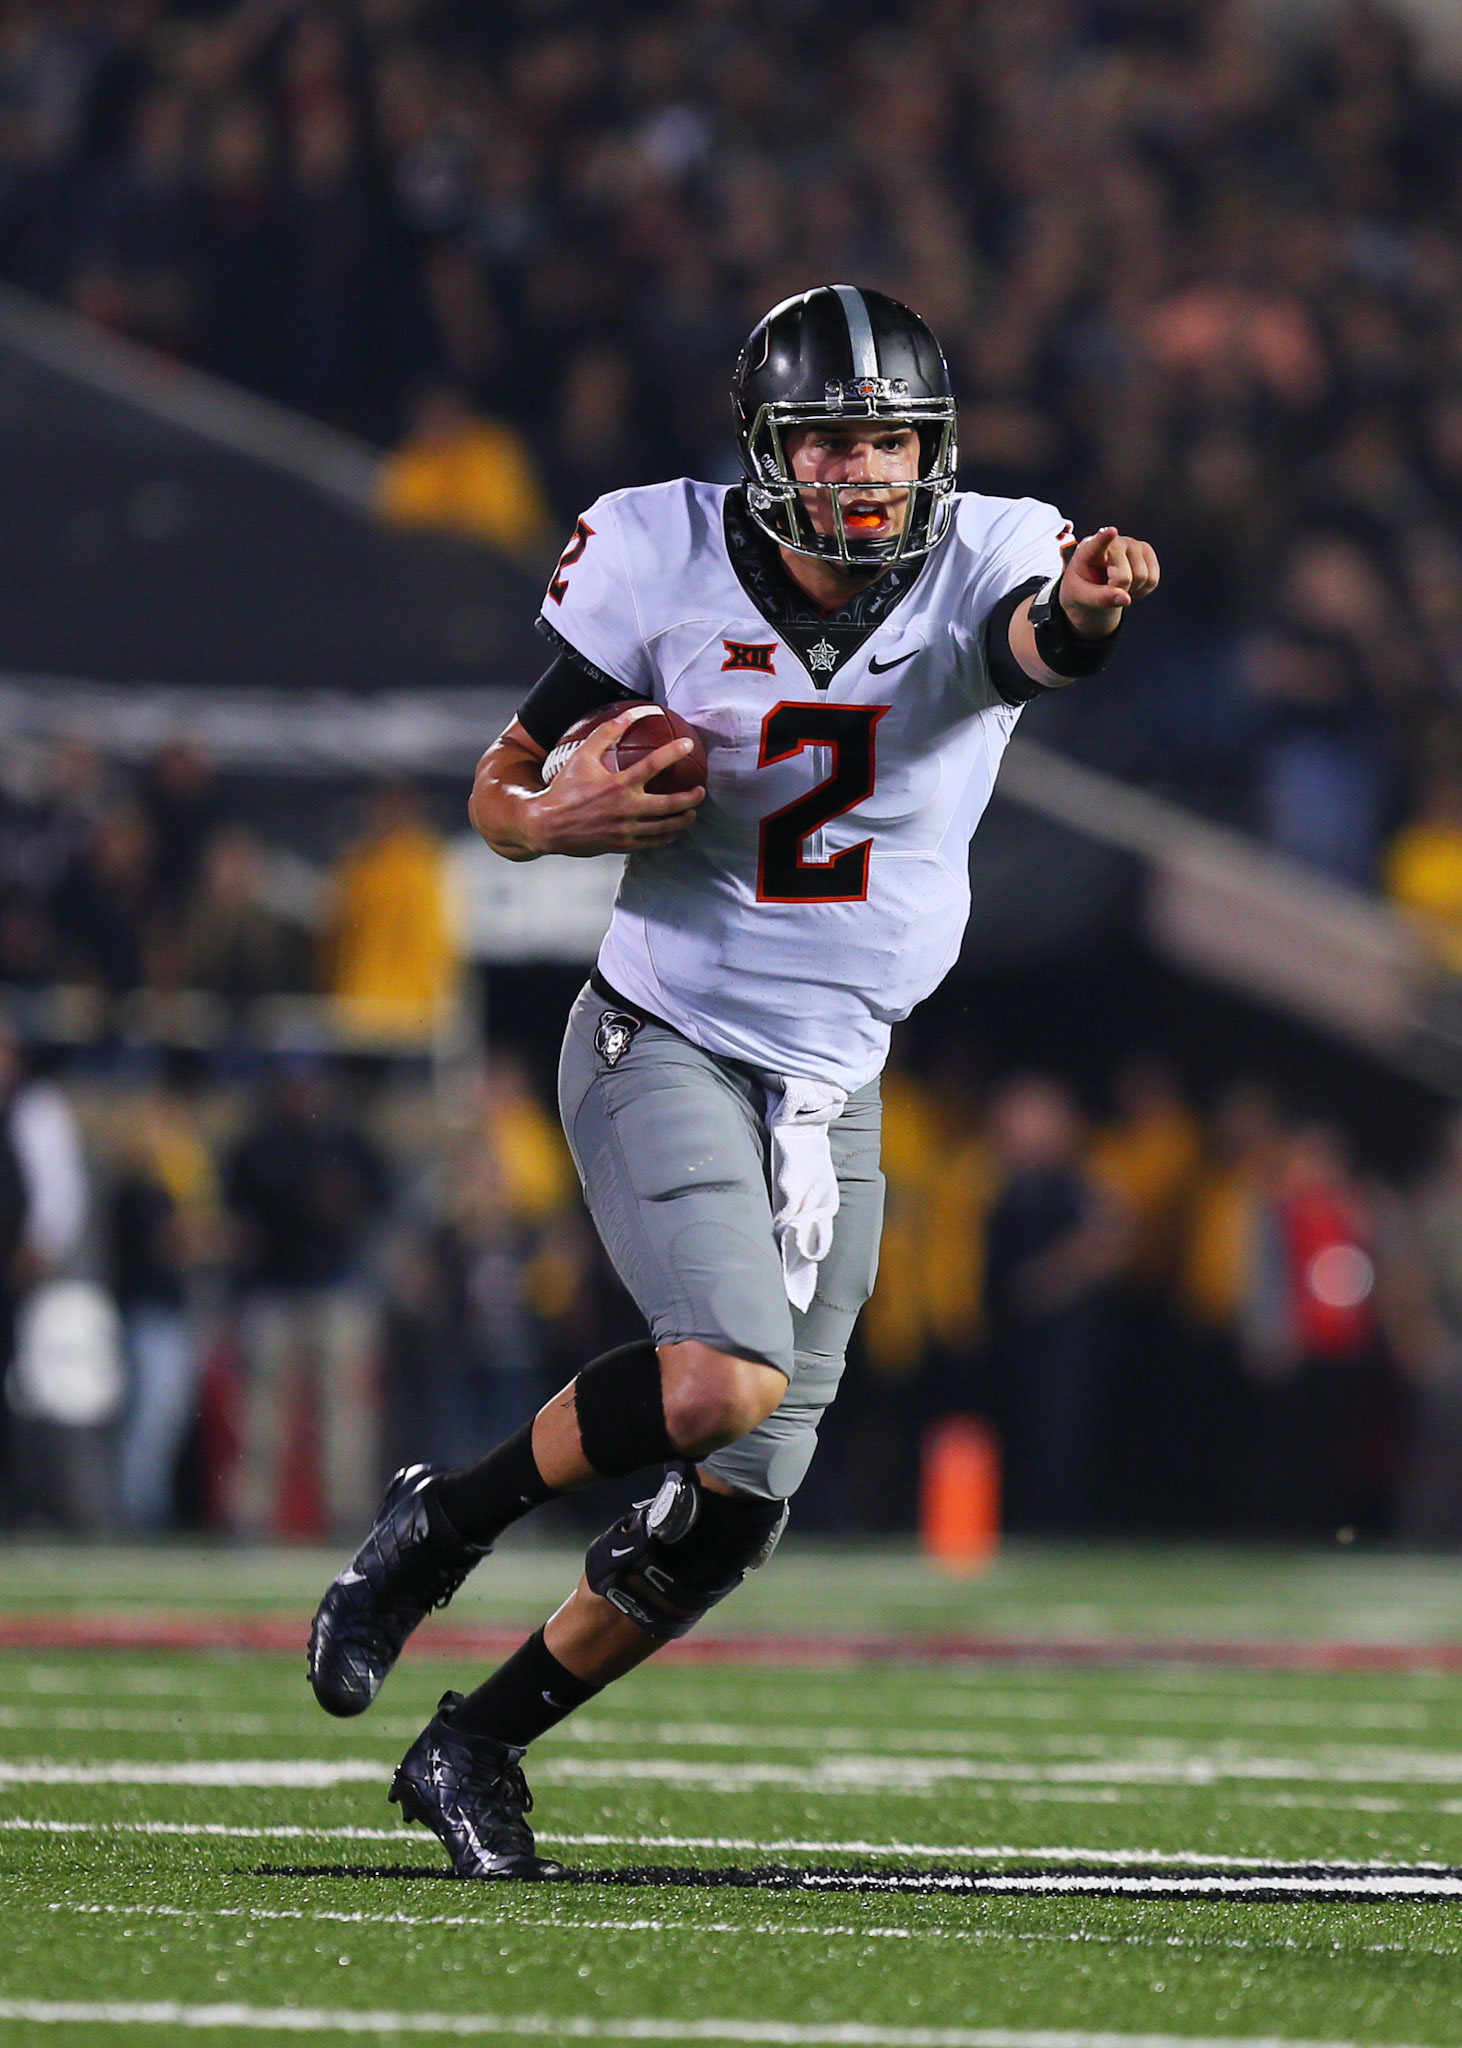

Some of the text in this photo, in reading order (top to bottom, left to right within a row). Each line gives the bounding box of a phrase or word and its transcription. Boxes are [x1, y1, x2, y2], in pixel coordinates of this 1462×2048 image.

[547, 517, 597, 607] 2
[722, 639, 778, 675] XII
[756, 700, 893, 903] 2
